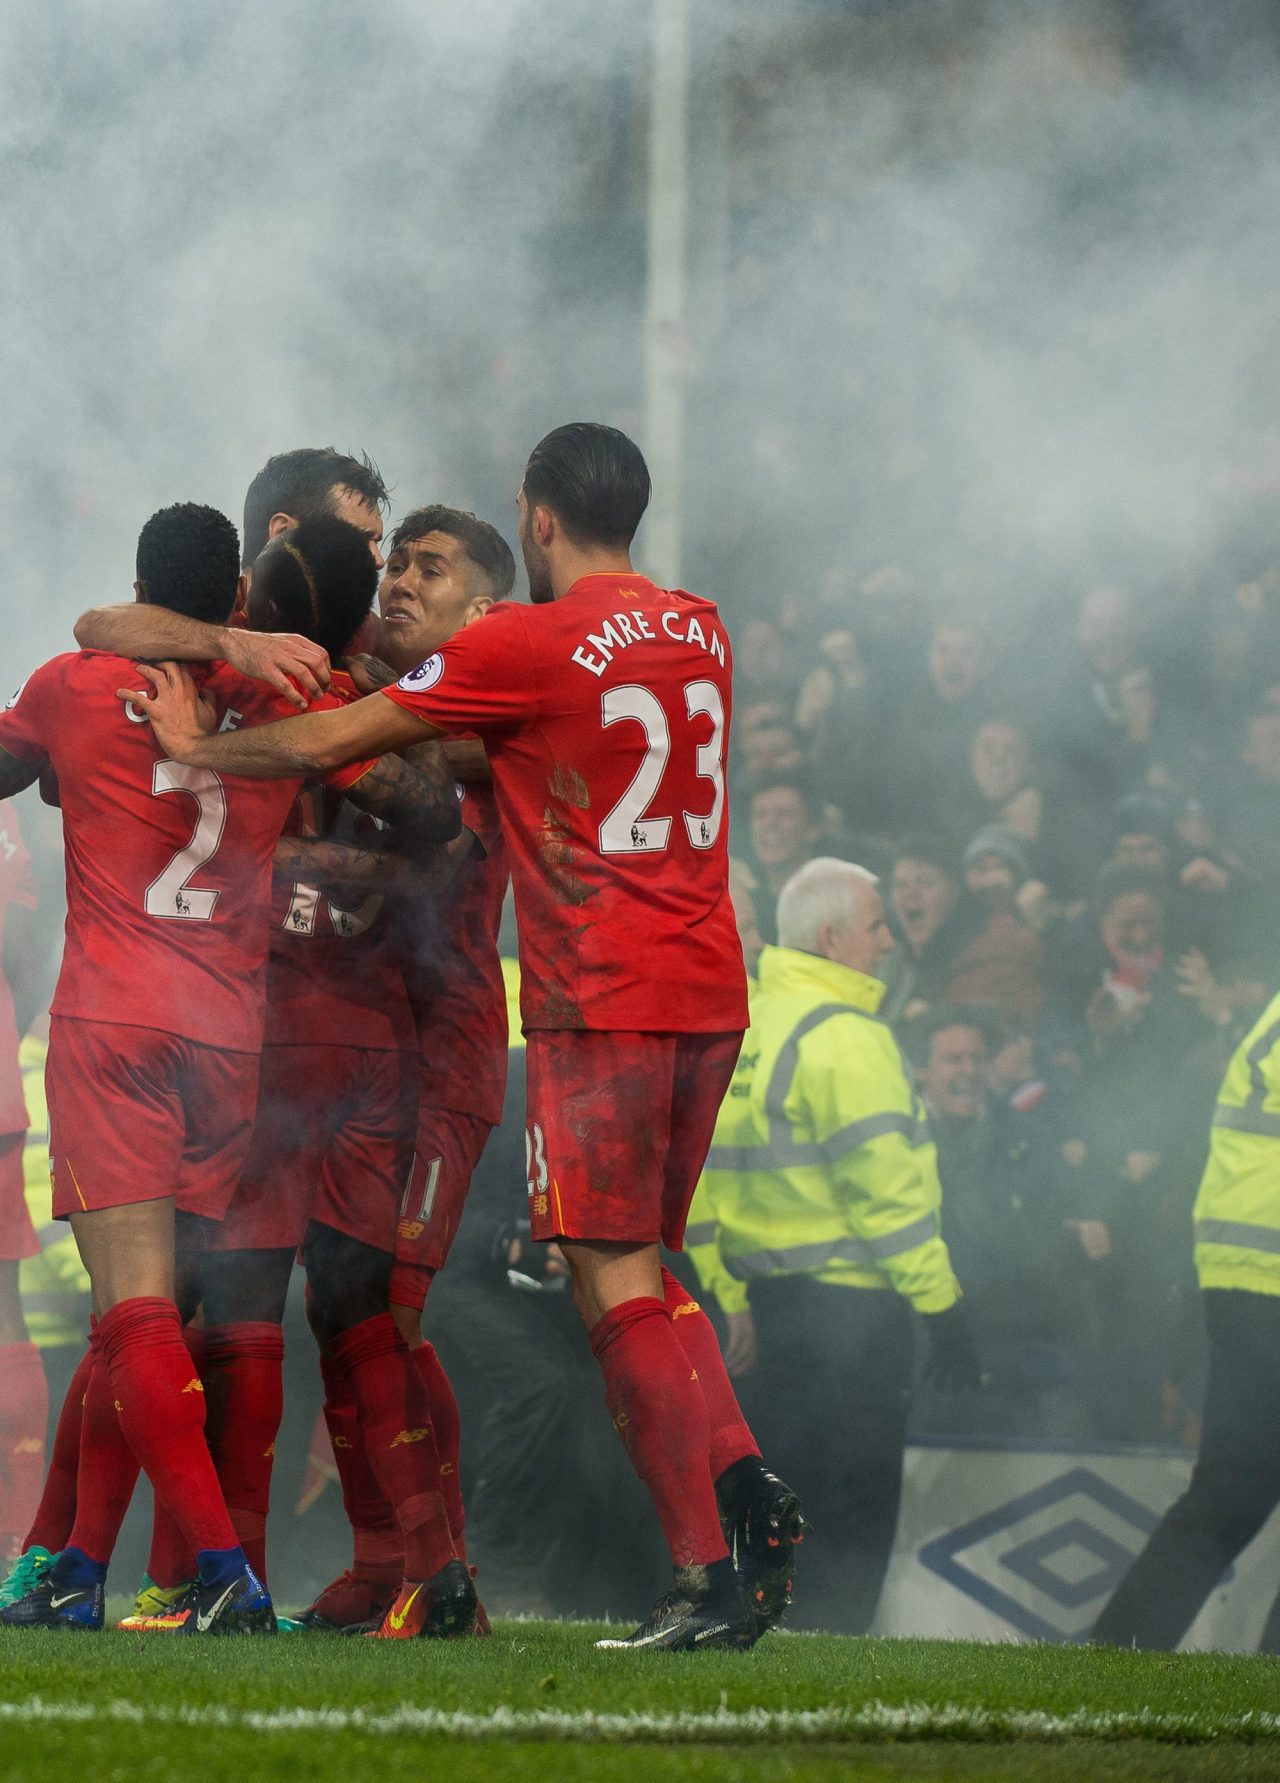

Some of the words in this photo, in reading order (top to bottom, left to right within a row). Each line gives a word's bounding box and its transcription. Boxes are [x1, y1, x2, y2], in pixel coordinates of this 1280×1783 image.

[571, 610, 656, 677] EMRE
[661, 611, 725, 668] CAN
[144, 758, 227, 921] 2
[599, 680, 725, 854] 23
